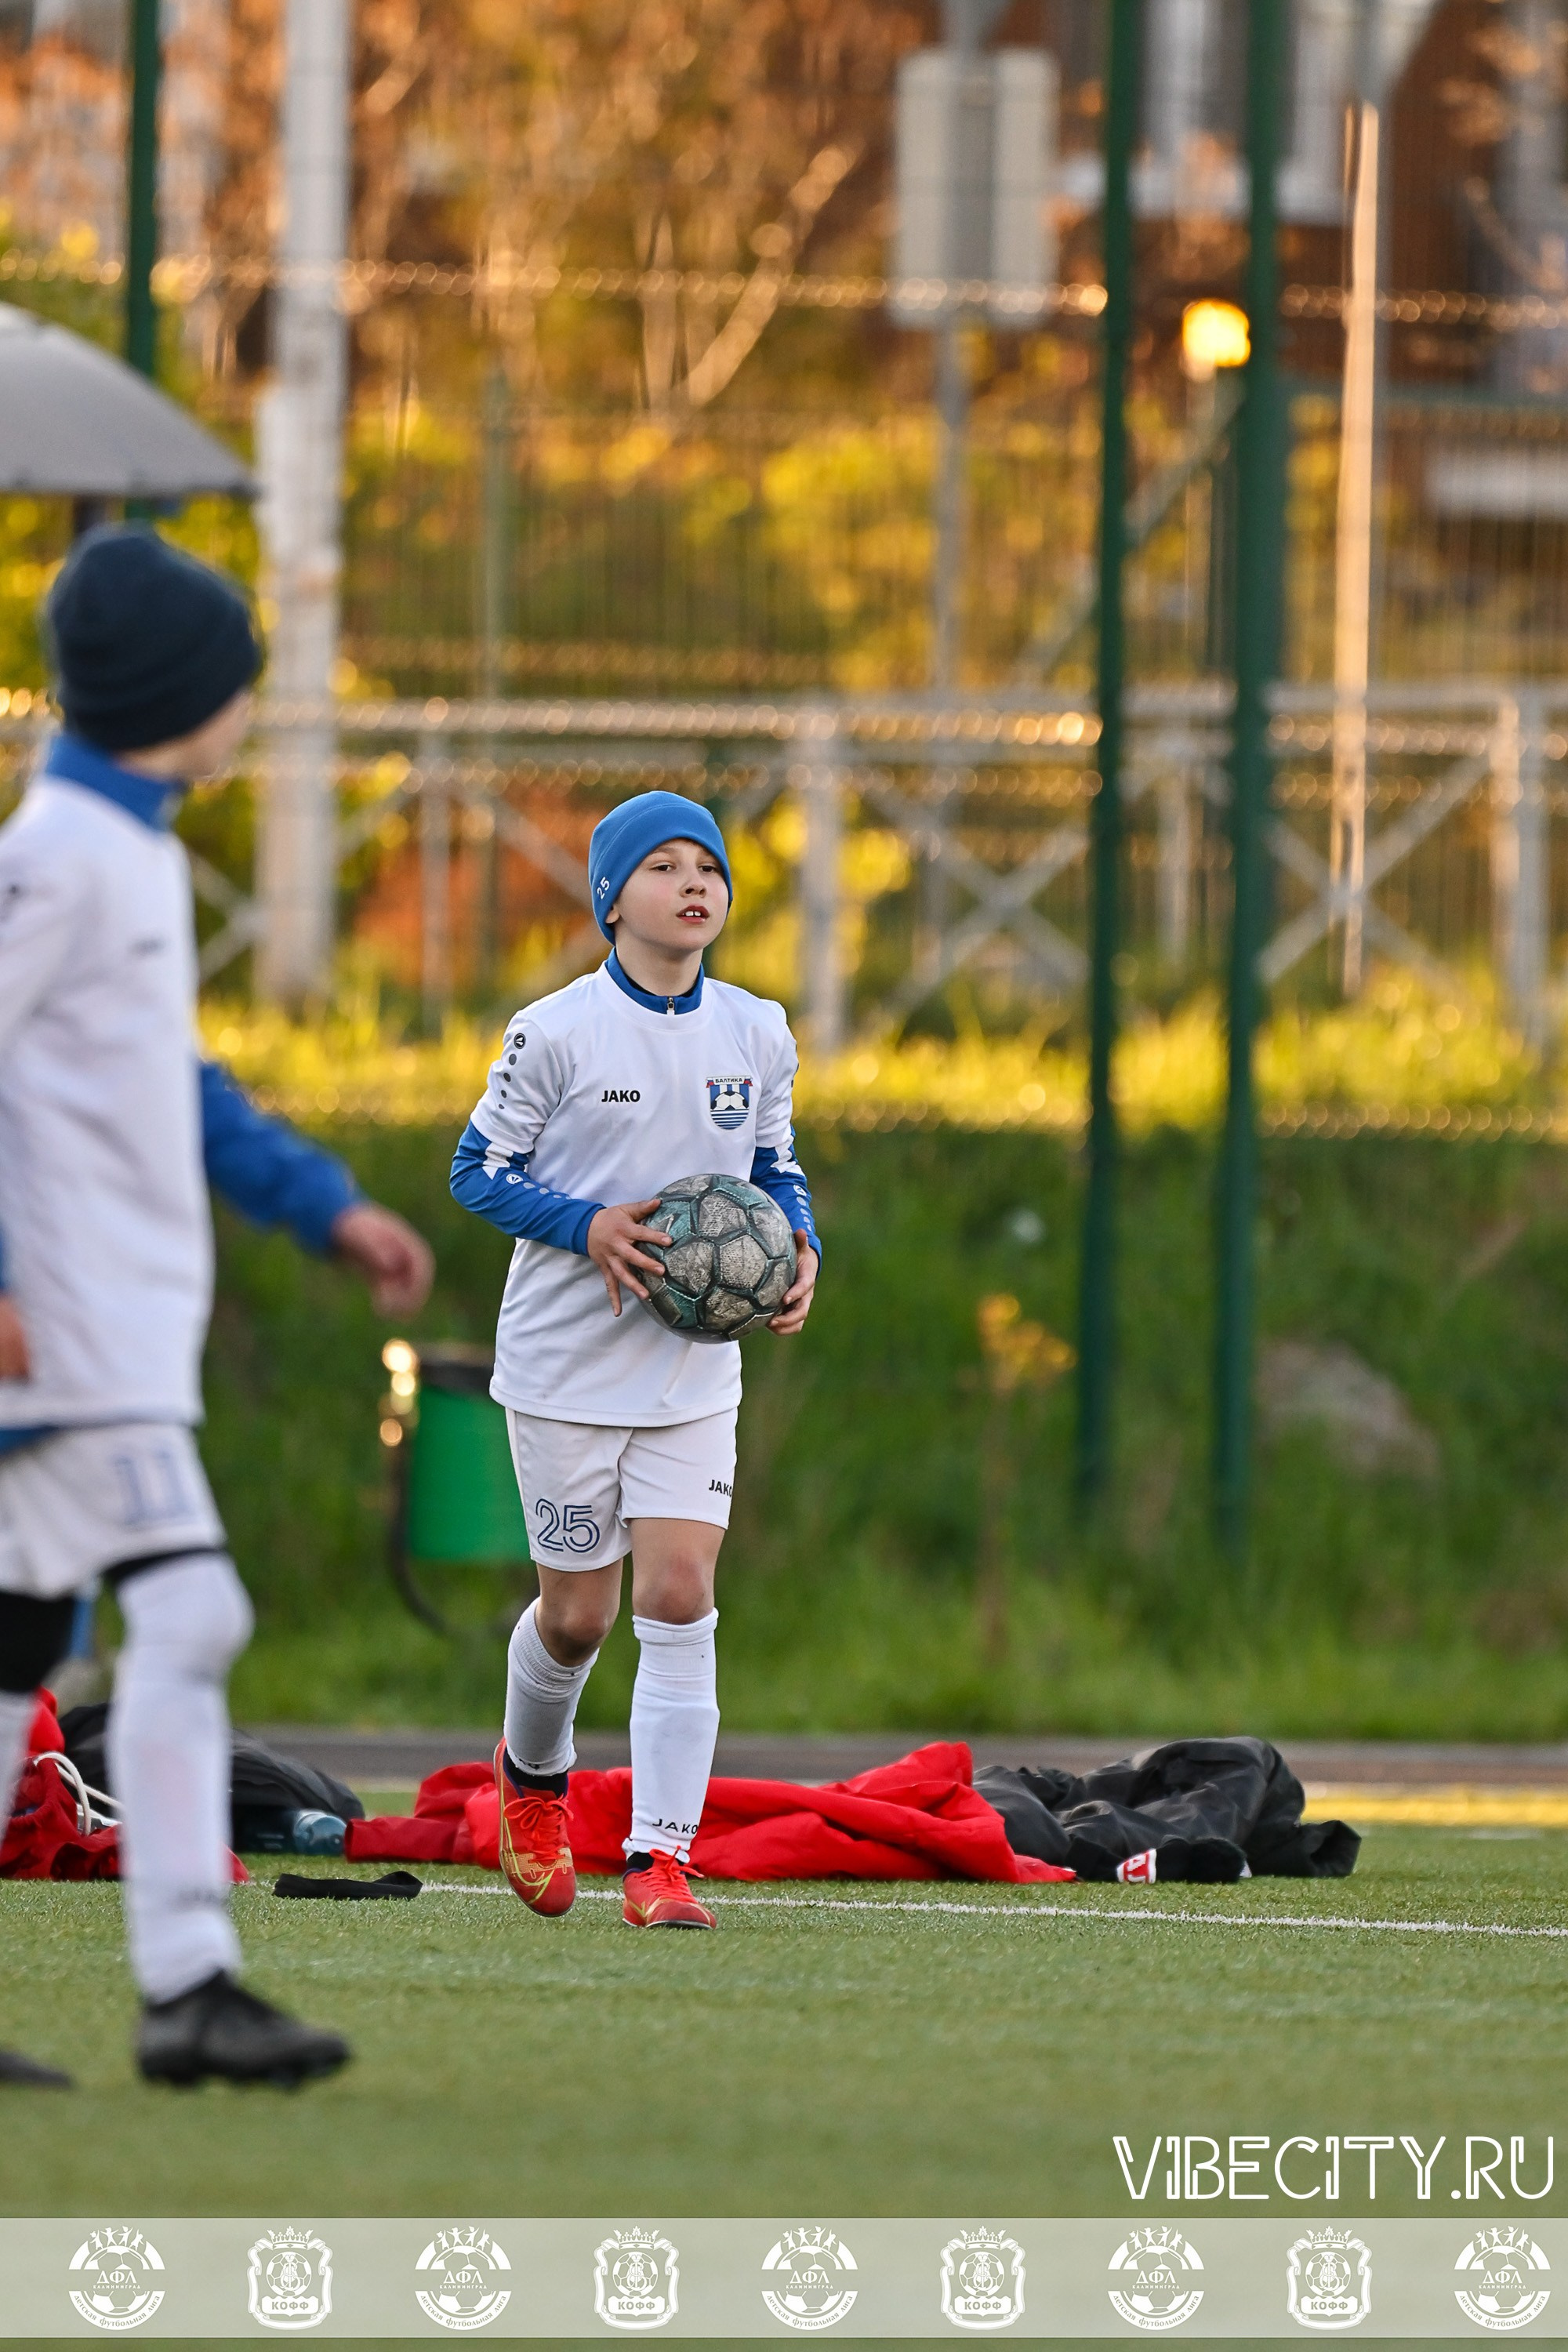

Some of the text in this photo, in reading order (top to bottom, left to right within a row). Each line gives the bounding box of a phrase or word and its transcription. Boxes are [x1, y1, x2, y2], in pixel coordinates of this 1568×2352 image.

[597, 877, 610, 899] 25
[601, 1090, 641, 1102] JAKO
[535, 1498, 600, 1552] 25
[652, 1818, 699, 1835] JAKO
